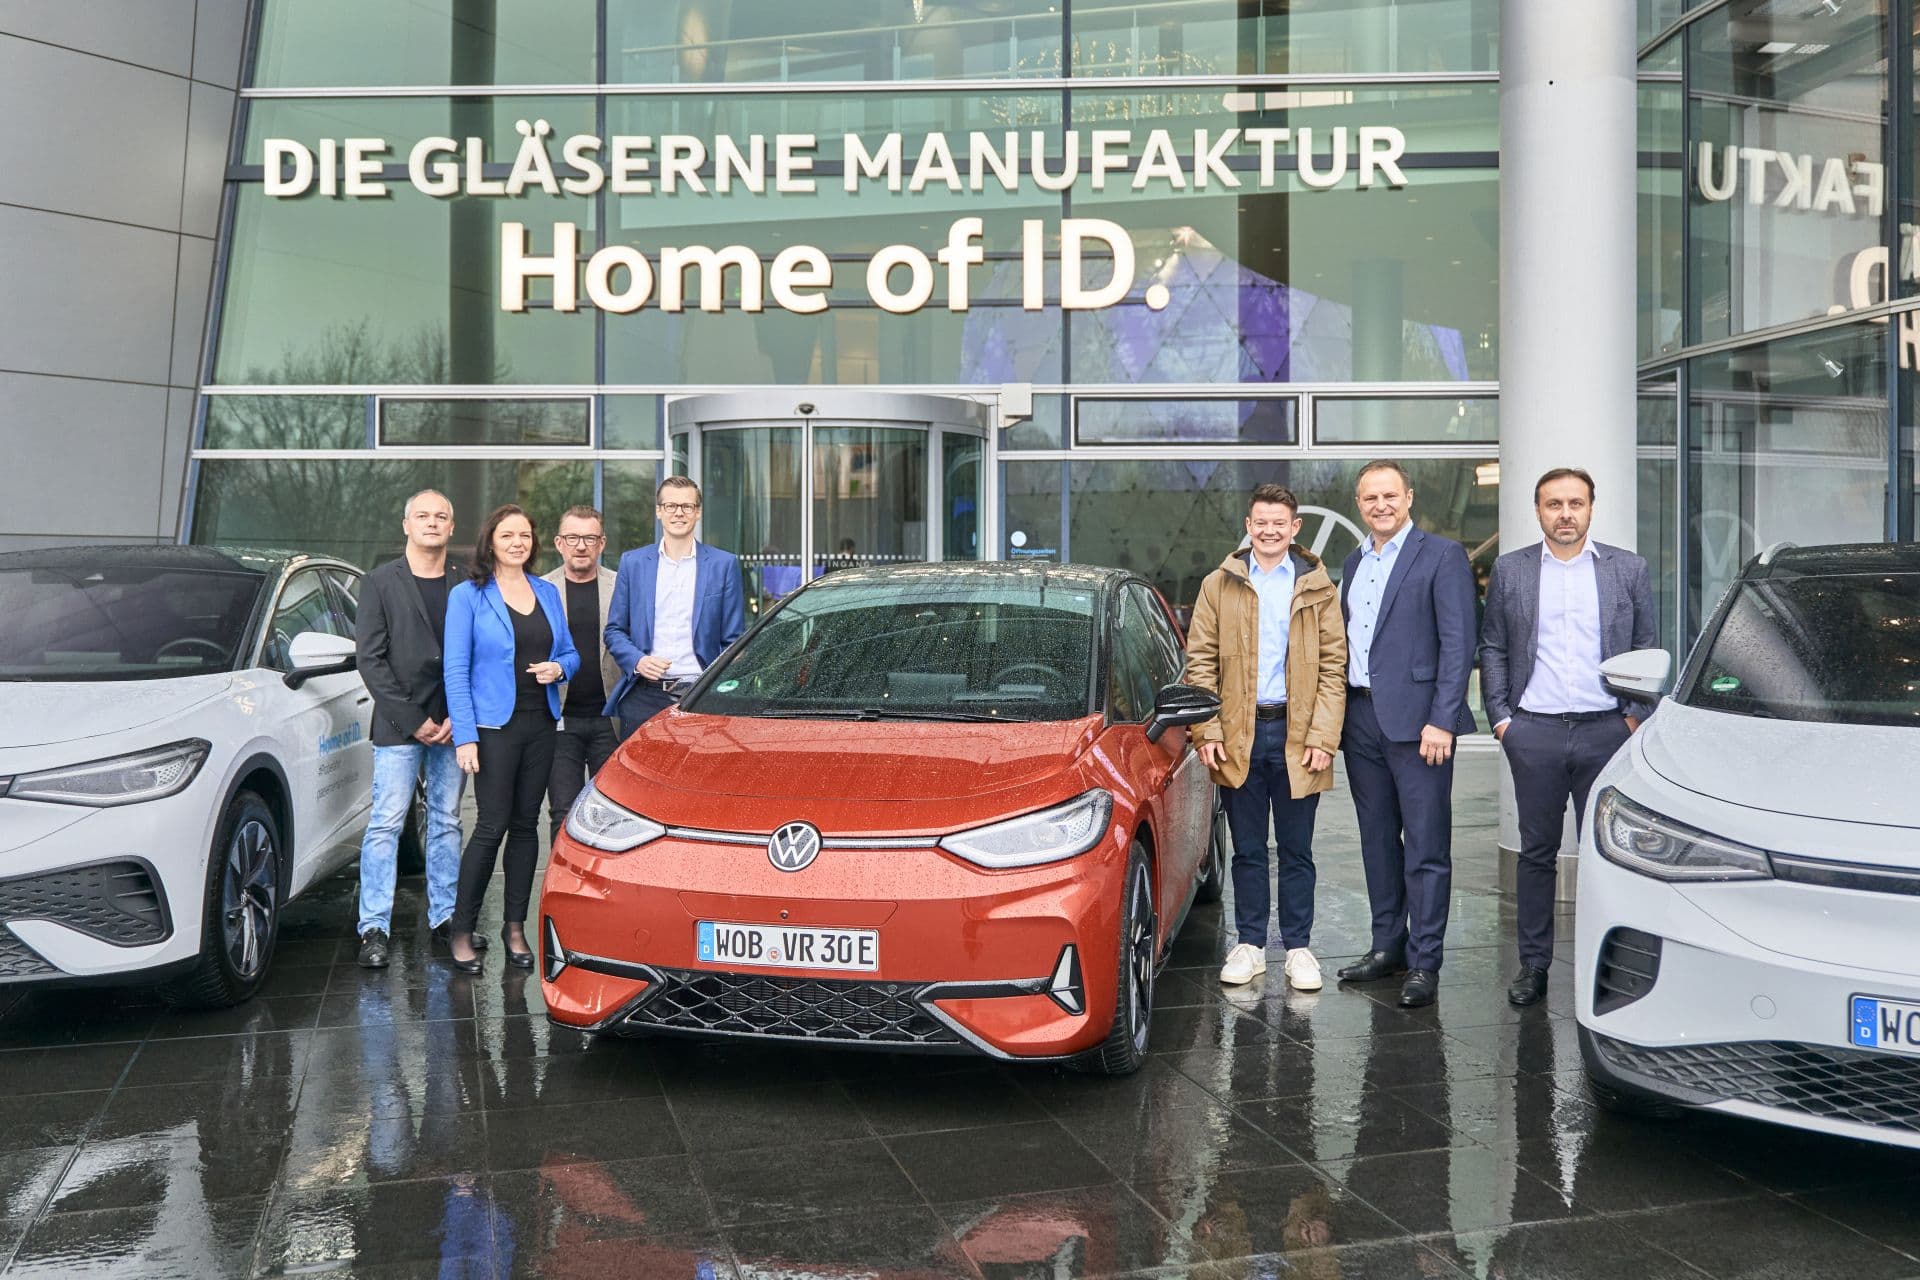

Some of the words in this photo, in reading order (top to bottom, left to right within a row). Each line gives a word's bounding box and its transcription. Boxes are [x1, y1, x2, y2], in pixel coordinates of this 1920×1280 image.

[264, 138, 387, 197] DIE
[409, 119, 816, 195] GLÄSERNE
[844, 126, 1408, 191] MANUFAKTUR
[502, 222, 833, 313] Home
[866, 217, 983, 312] of
[1023, 218, 1170, 310] ID.
[716, 928, 763, 959] WOB
